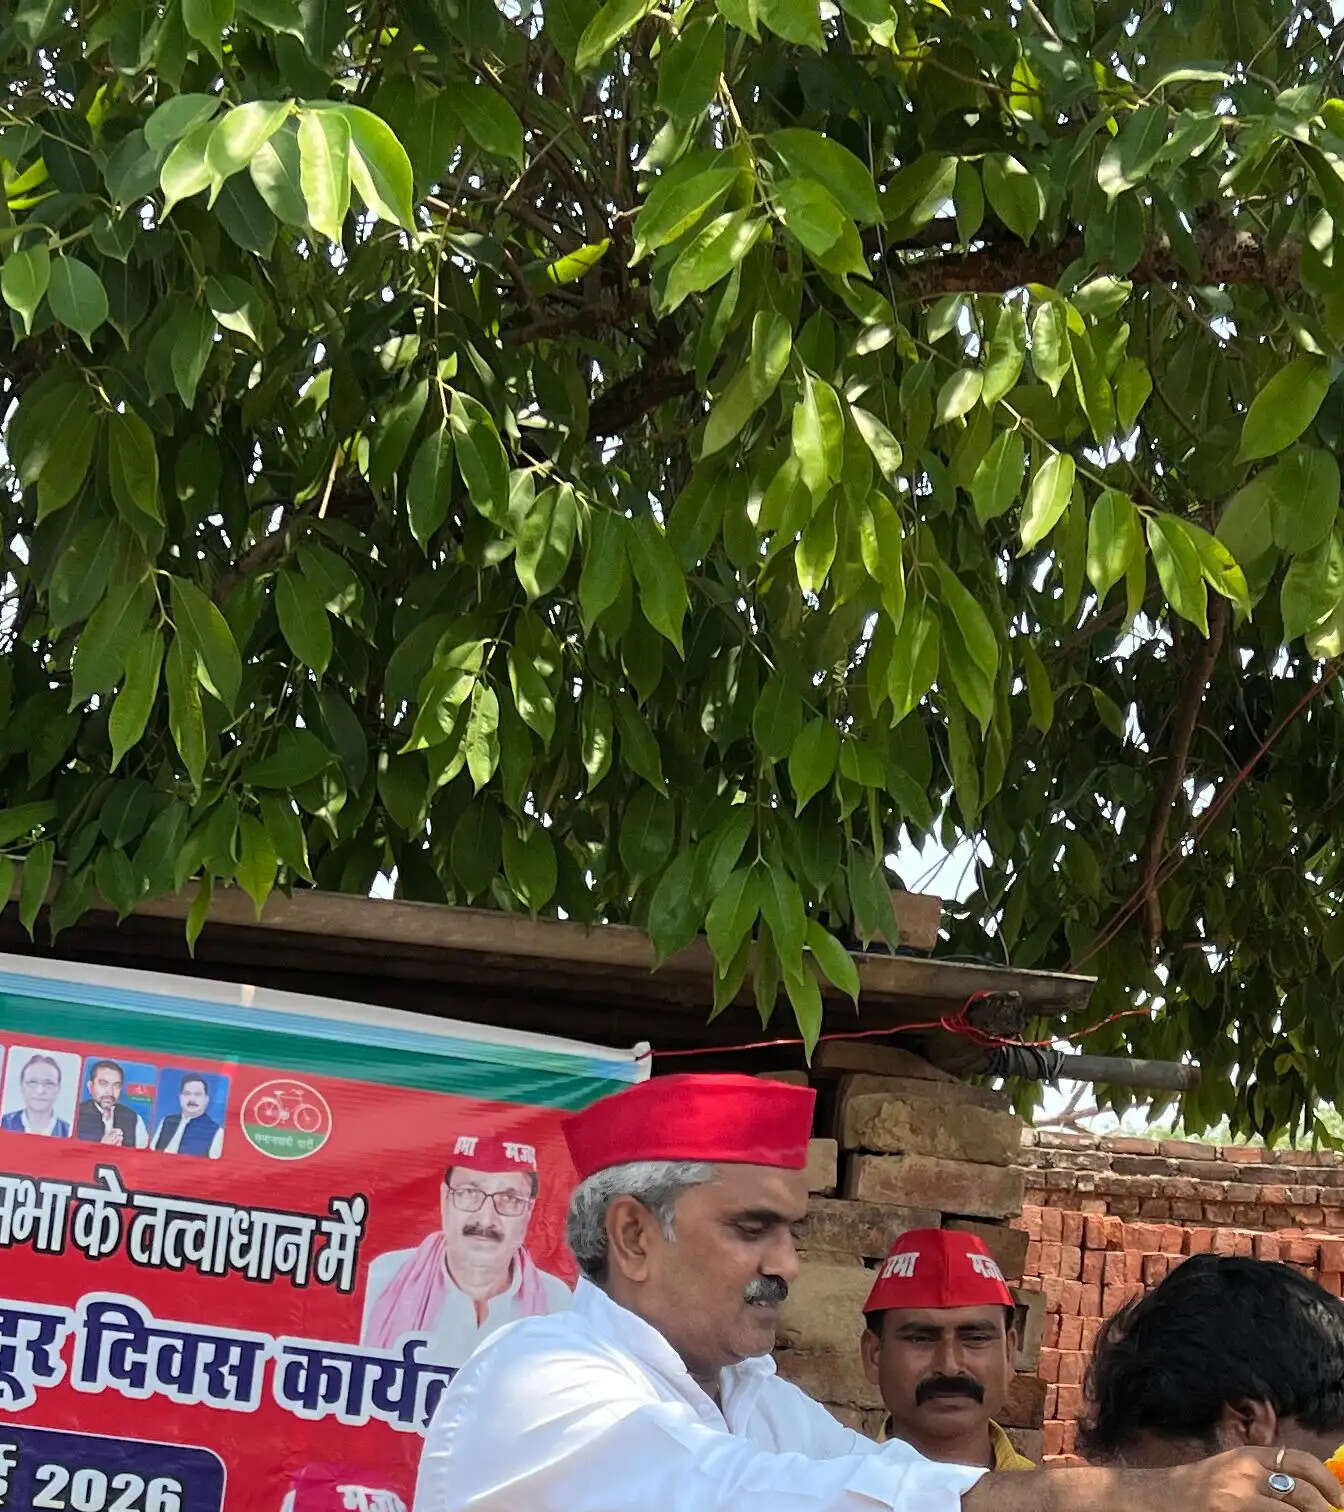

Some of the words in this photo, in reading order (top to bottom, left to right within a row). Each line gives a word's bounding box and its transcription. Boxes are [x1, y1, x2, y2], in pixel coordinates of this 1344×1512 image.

[74, 1167, 128, 1258] के
[131, 1194, 316, 1286] तत्वाधान
[316, 1196, 366, 1292] में
[81, 1301, 265, 1402] दिवस
[282, 1339, 460, 1428] कार्य
